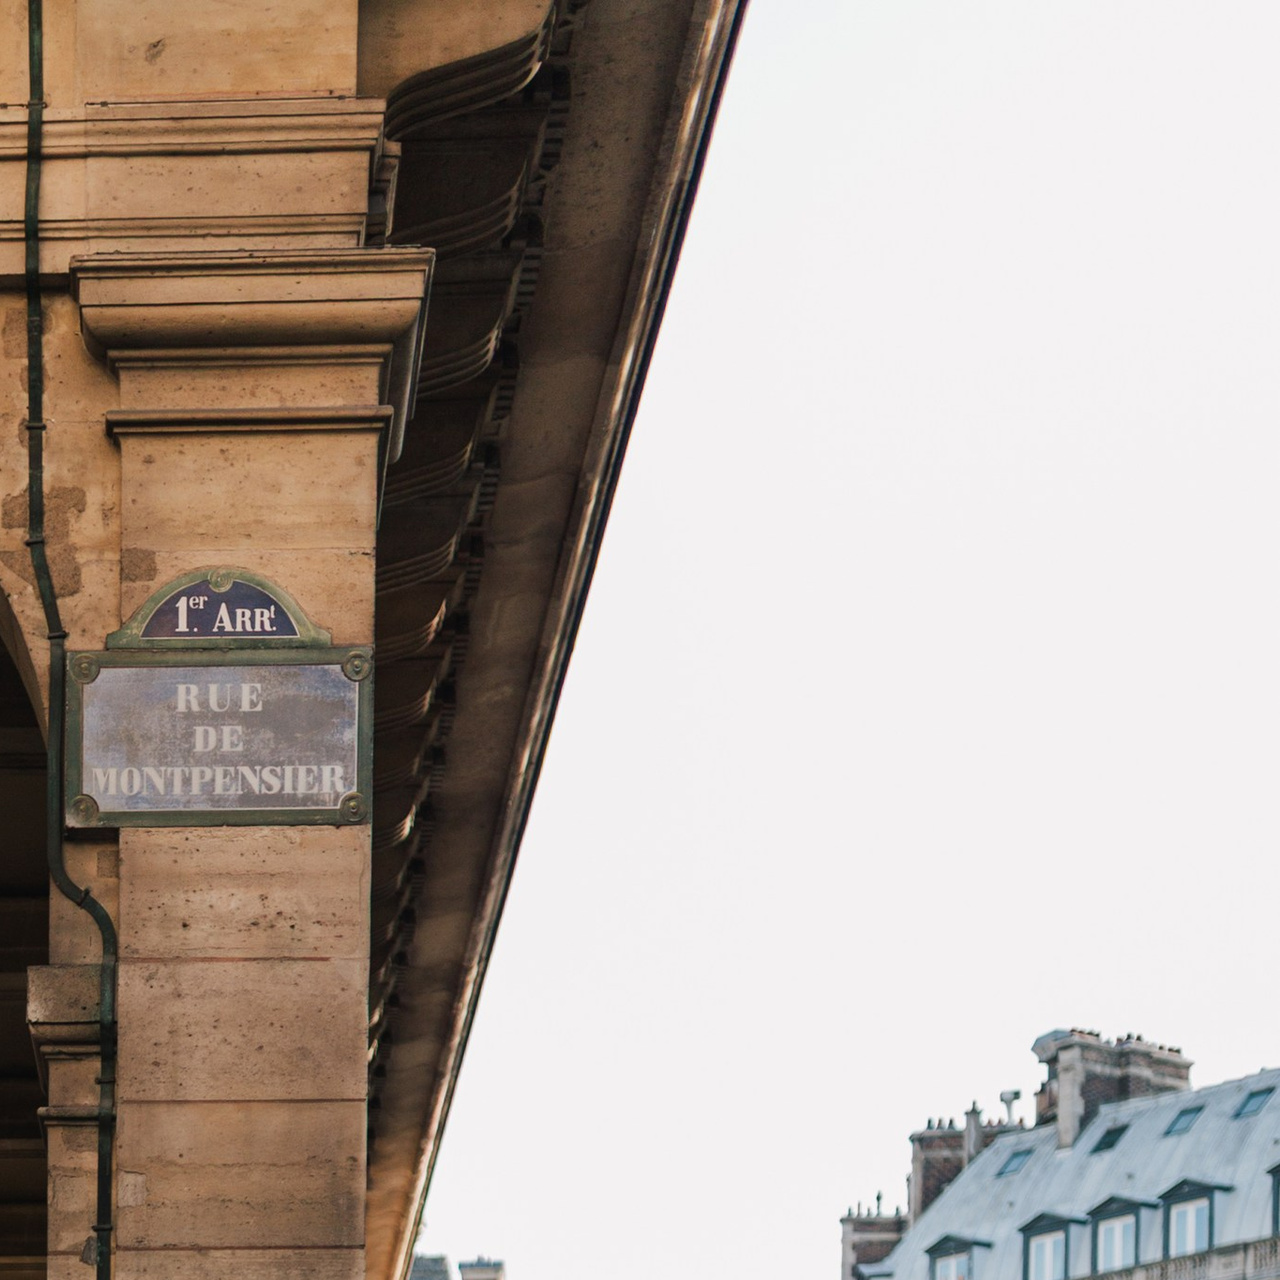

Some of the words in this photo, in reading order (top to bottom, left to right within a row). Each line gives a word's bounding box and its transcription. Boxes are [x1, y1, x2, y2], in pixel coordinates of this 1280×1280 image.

[175, 682, 263, 713] RUE
[193, 725, 244, 752] DE
[91, 765, 346, 796] MONTPENSIER
